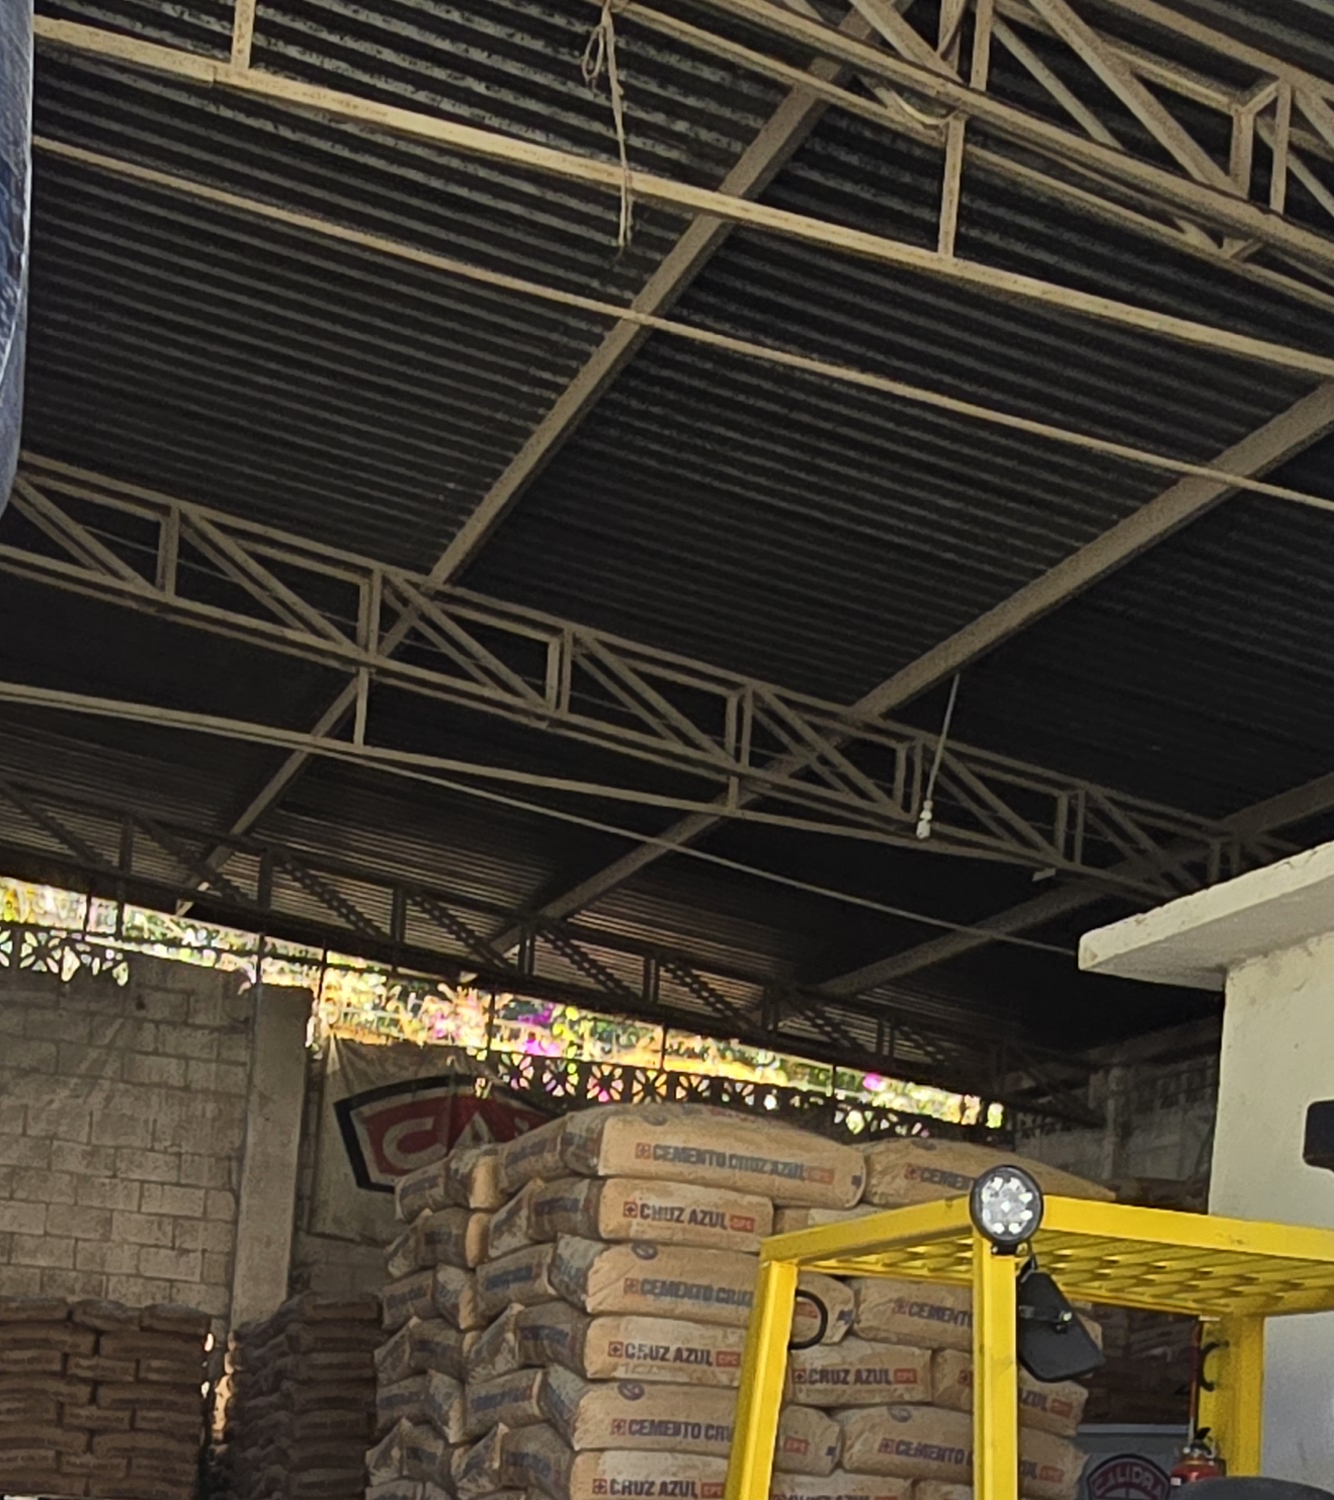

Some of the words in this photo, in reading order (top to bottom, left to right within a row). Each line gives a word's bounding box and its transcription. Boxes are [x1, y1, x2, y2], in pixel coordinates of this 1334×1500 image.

[652, 1143, 726, 1169] CEMENTO
[920, 1166, 974, 1190] CEMEN
[639, 1203, 684, 1224] CRUZ
[687, 1207, 728, 1230] AZUL
[624, 1342, 671, 1361] CRUZ
[673, 1347, 713, 1367] AZUL
[807, 1368, 850, 1385] CRUZ
[854, 1368, 892, 1386] AZUL
[628, 1419, 702, 1441] CEMENTO
[704, 1425, 732, 1443] CRU
[895, 1440, 965, 1465] CEMENTO
[610, 1478, 655, 1497] CRUZ
[658, 1479, 698, 1499] AZUL
